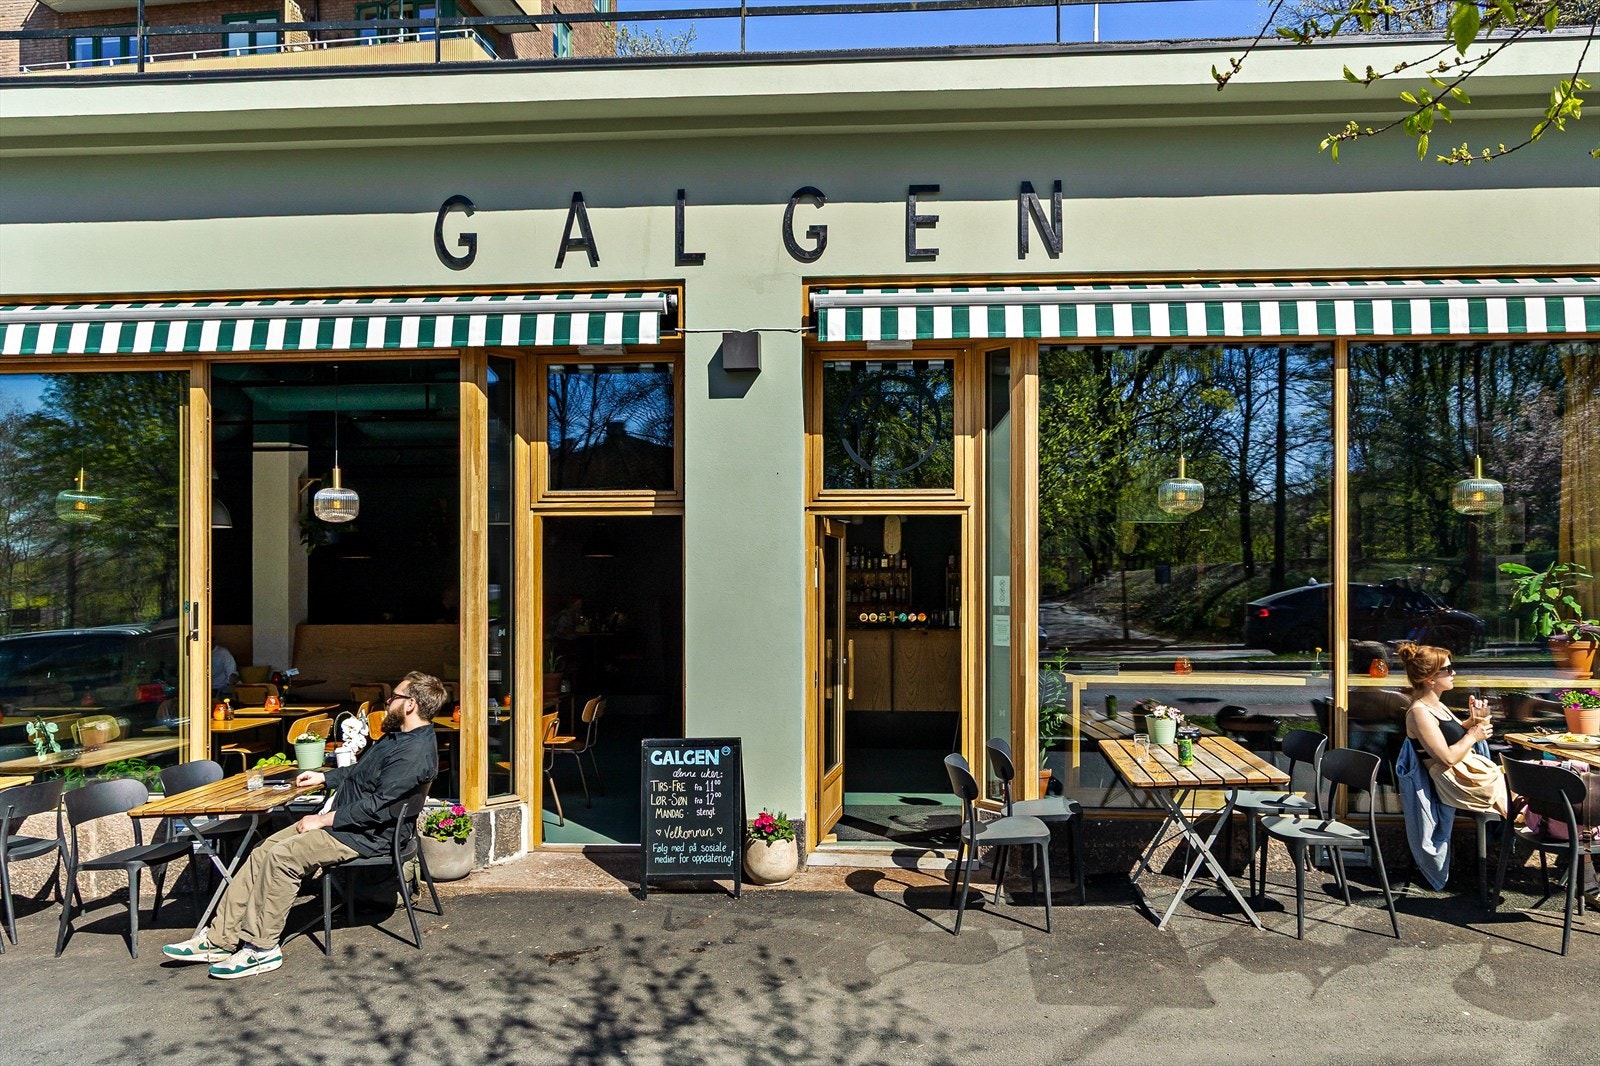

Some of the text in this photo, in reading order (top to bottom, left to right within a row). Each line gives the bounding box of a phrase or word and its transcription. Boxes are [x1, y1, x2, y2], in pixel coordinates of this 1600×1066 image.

[434, 180, 1062, 270] GALGEN
[650, 749, 720, 765] GALGEN
[672, 768, 697, 778] denne
[694, 783, 703, 791] fra
[694, 796, 703, 804] fra
[696, 807, 716, 819] stengt
[664, 825, 714, 839] Velkommen
[652, 841, 727, 855] Følg med på sosiale
[655, 850, 734, 867] medier for oppdatering!
